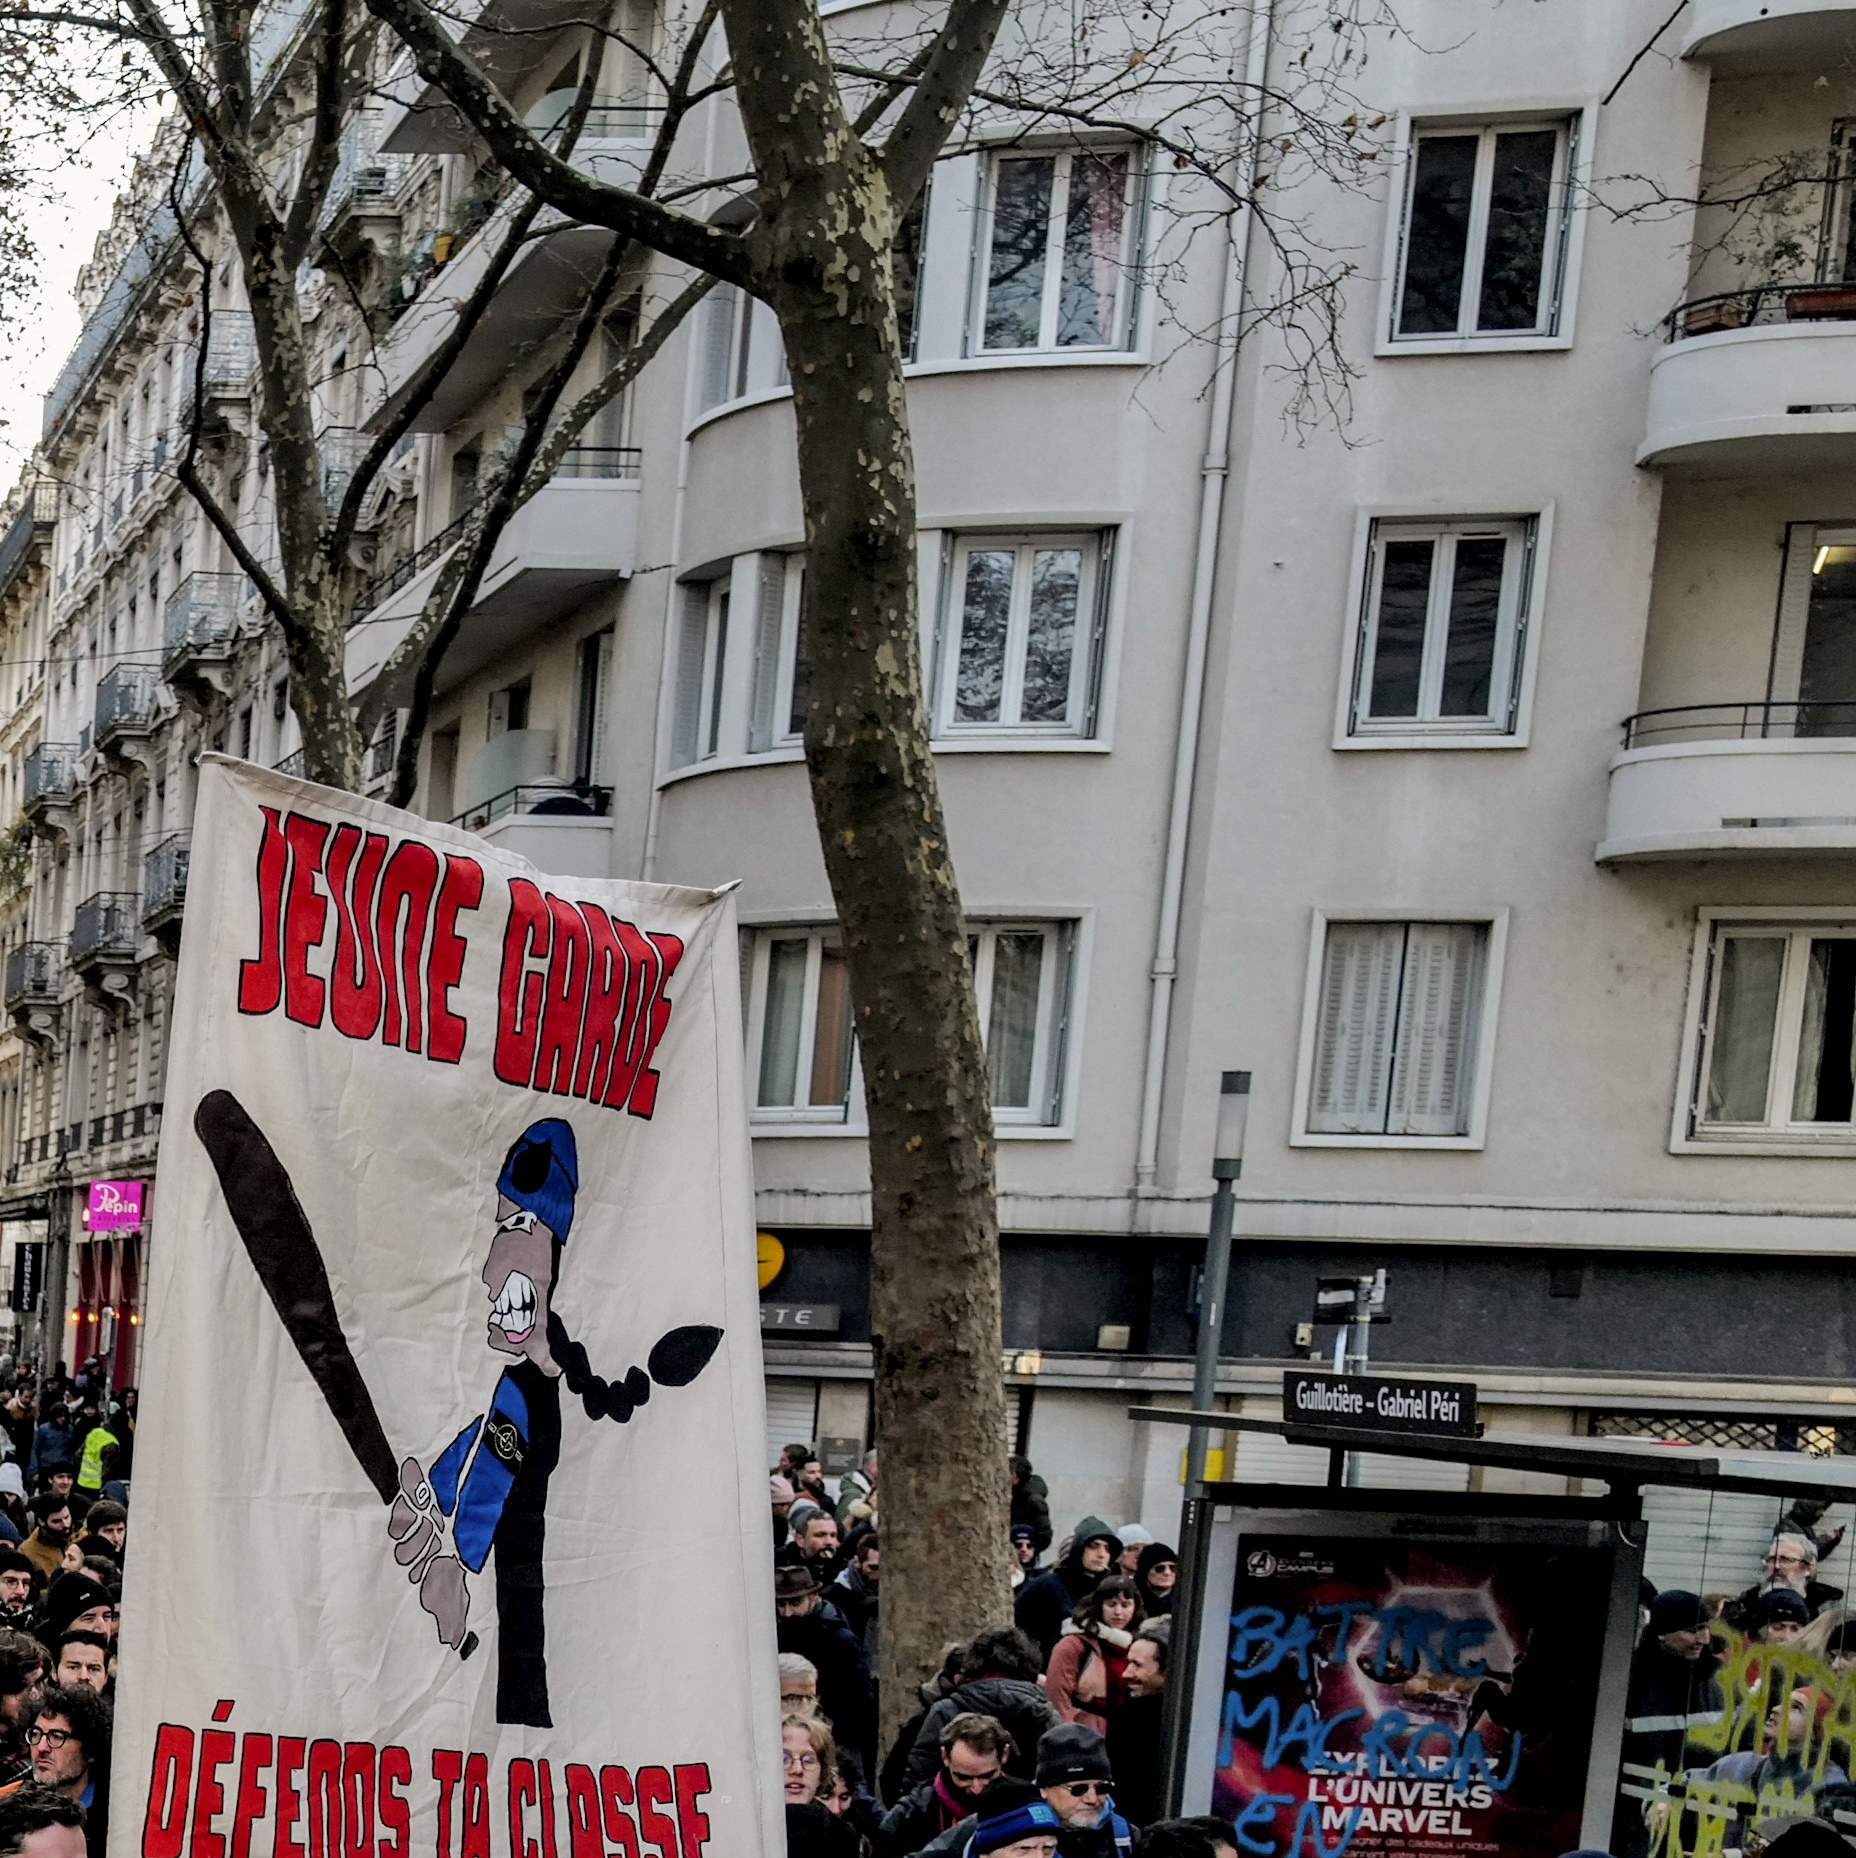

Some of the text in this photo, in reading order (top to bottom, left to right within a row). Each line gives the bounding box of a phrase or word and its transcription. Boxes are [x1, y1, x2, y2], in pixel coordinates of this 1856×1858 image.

[238, 804, 685, 1121] JEUNE GARDE
[1296, 1380, 1363, 1413] Guillotière
[1377, 1386, 1427, 1419] Gabriel
[1431, 1391, 1460, 1422] Péri
[1226, 1602, 1496, 1681] BATTRE
[1217, 1689, 1523, 1793] MACRON
[1322, 1807, 1473, 1837] MARVEL
